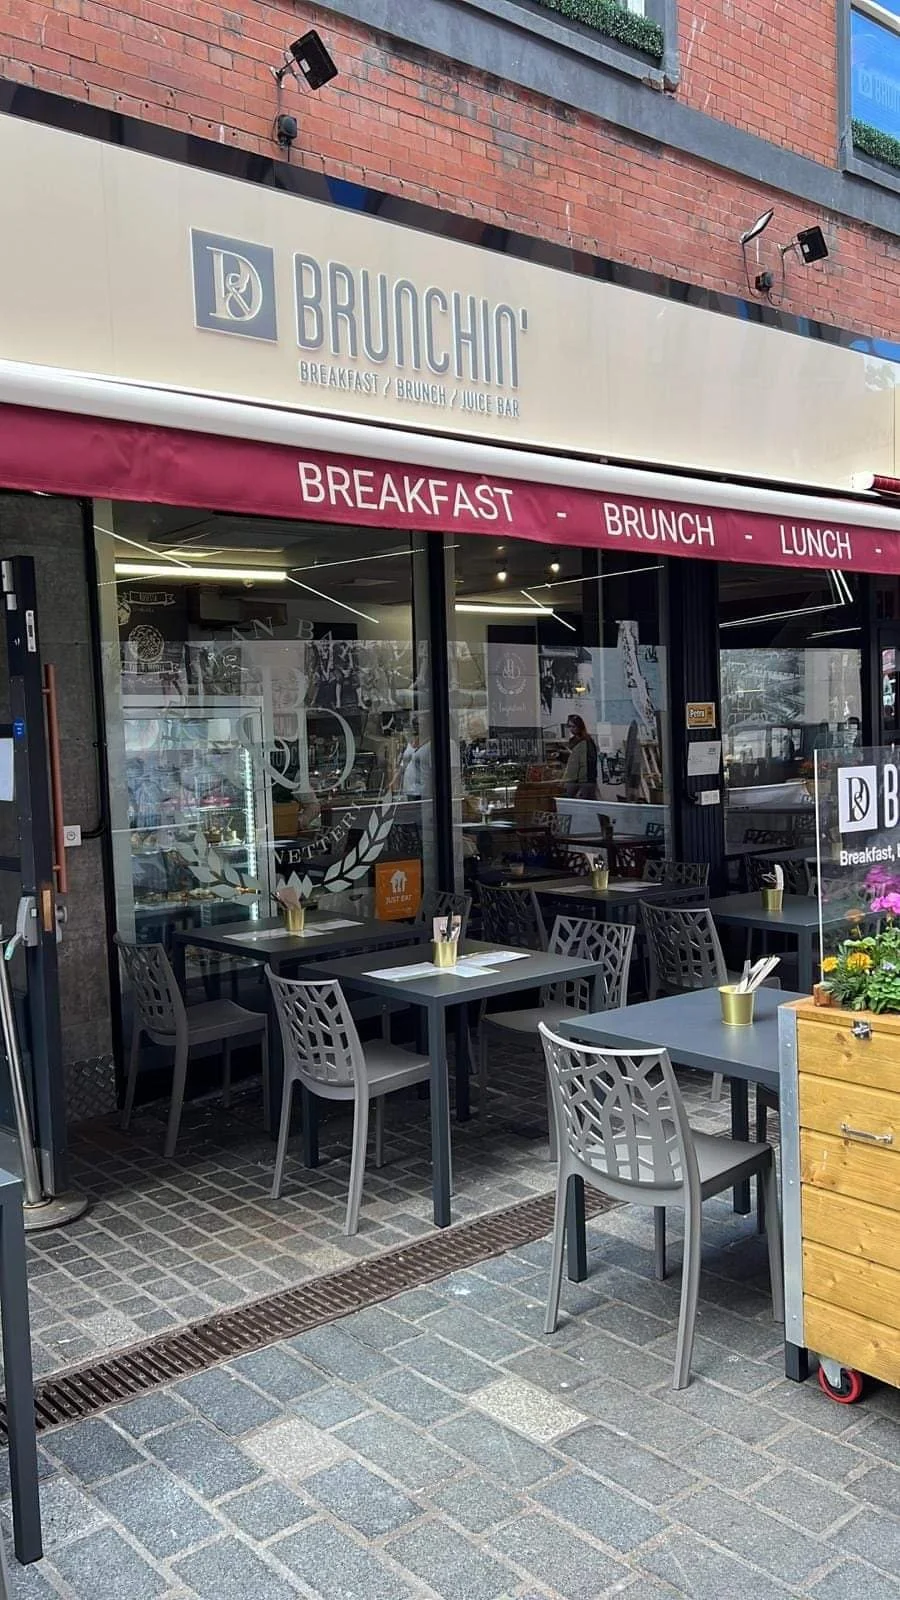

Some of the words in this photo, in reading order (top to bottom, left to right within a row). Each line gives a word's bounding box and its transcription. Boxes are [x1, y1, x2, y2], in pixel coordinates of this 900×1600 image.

[293, 251, 529, 389] BRUNCHIN'
[299, 360, 378, 395] BREAKFAST
[396, 378, 446, 405] BRUNCH
[462, 390, 492, 414] JUICE
[497, 397, 520, 418] BAR
[298, 461, 514, 523] BREAKFAST
[603, 502, 715, 546] BRUNCH
[779, 524, 852, 560] LUNCH
[840, 844, 895, 866] Breakfast,
